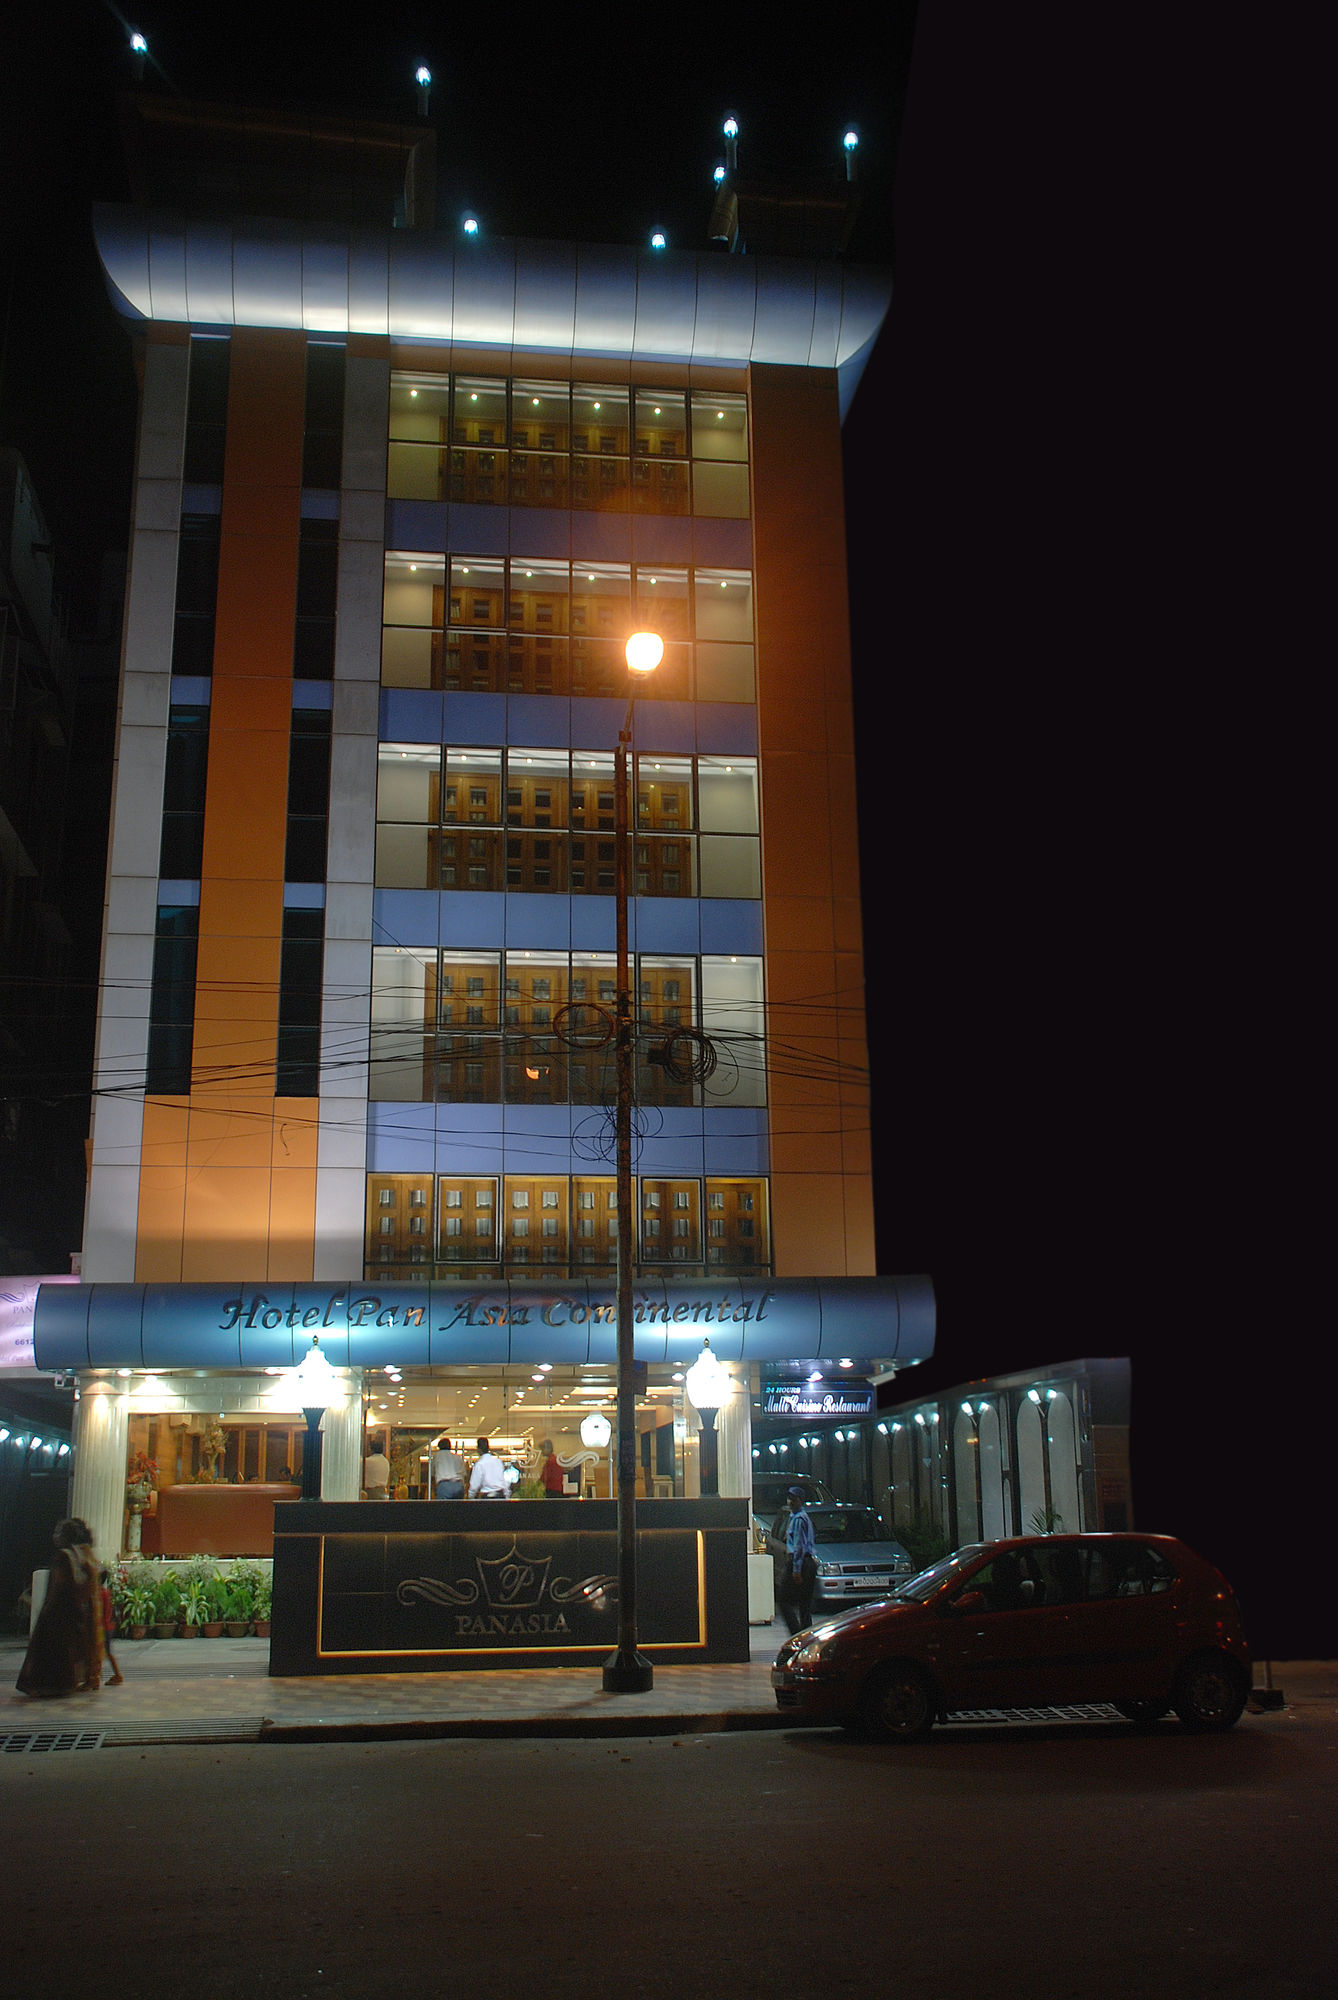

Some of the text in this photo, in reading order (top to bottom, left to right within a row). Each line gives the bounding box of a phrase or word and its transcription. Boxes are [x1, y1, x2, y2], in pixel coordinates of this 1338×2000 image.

[219, 1290, 775, 1331] Hotel Pan Asia Coninental
[823, 1394, 871, 1413] Restaurant
[454, 1613, 571, 1636] PANASIA
